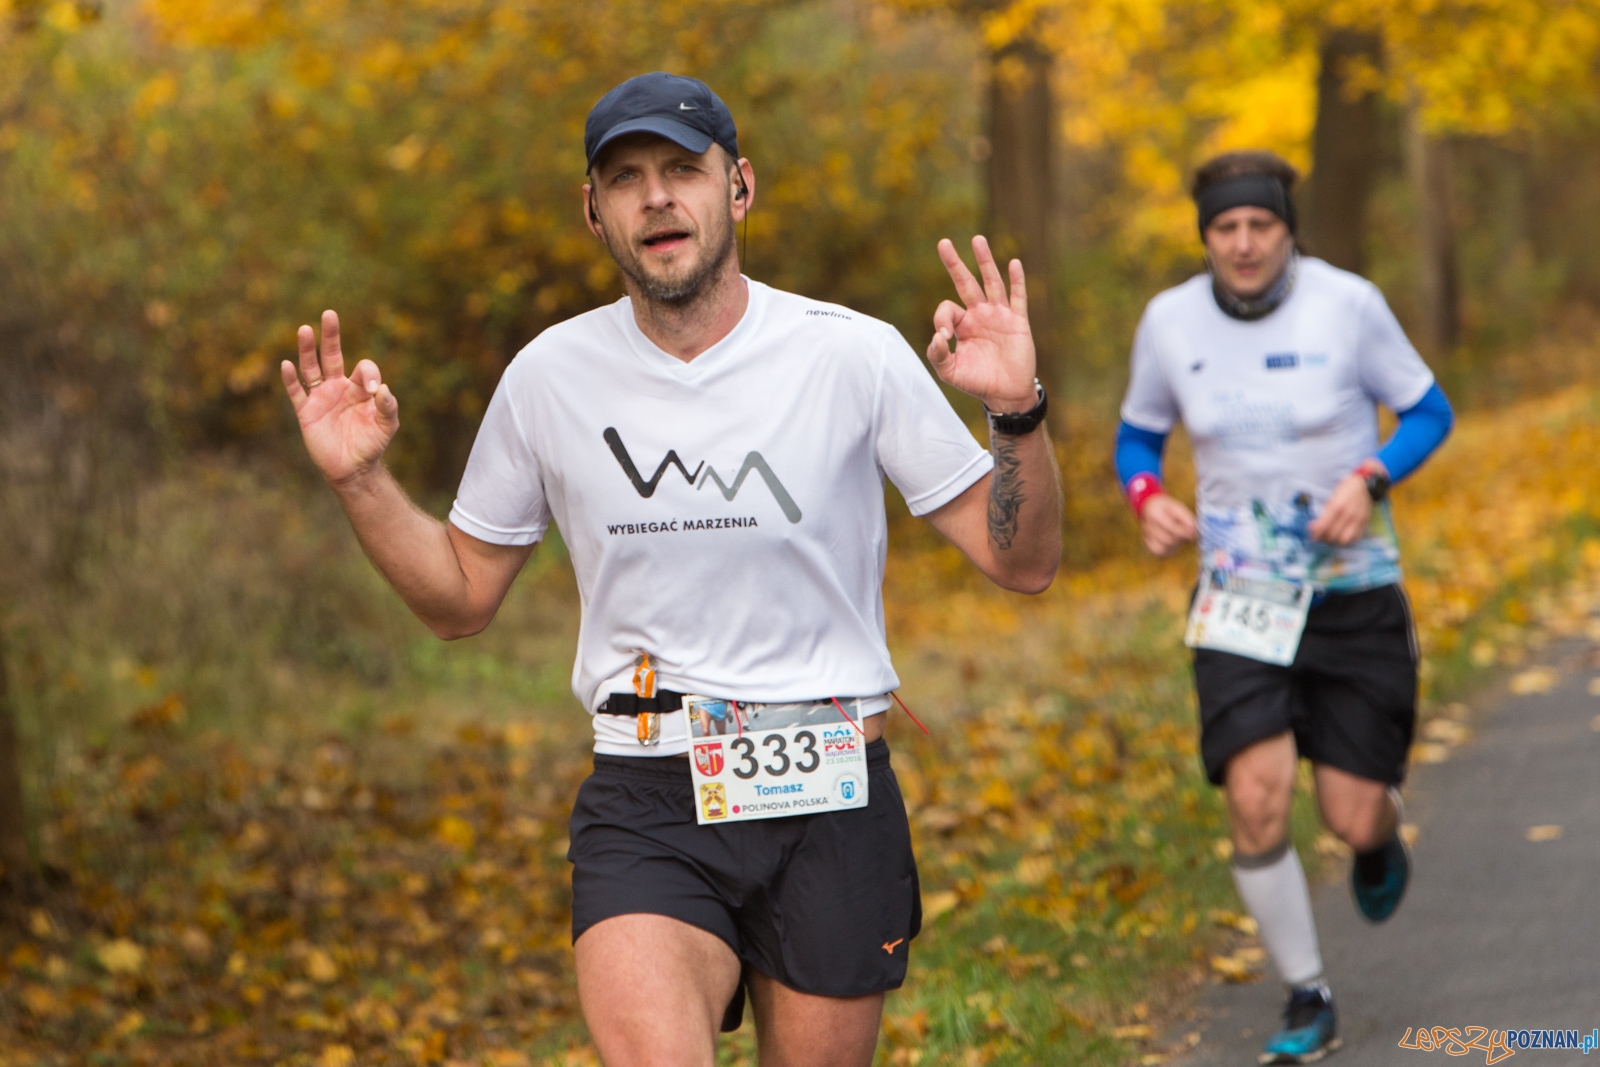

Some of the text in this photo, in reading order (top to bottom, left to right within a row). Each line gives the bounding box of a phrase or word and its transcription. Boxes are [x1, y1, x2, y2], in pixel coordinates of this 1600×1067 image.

[805, 309, 852, 320] newline
[607, 516, 758, 535] WYBIEGAĆ MARZENIA
[730, 730, 820, 780] 333
[753, 782, 804, 797] Tomasz
[742, 801, 791, 813] POLINOVA
[793, 796, 829, 808] POLSKA
